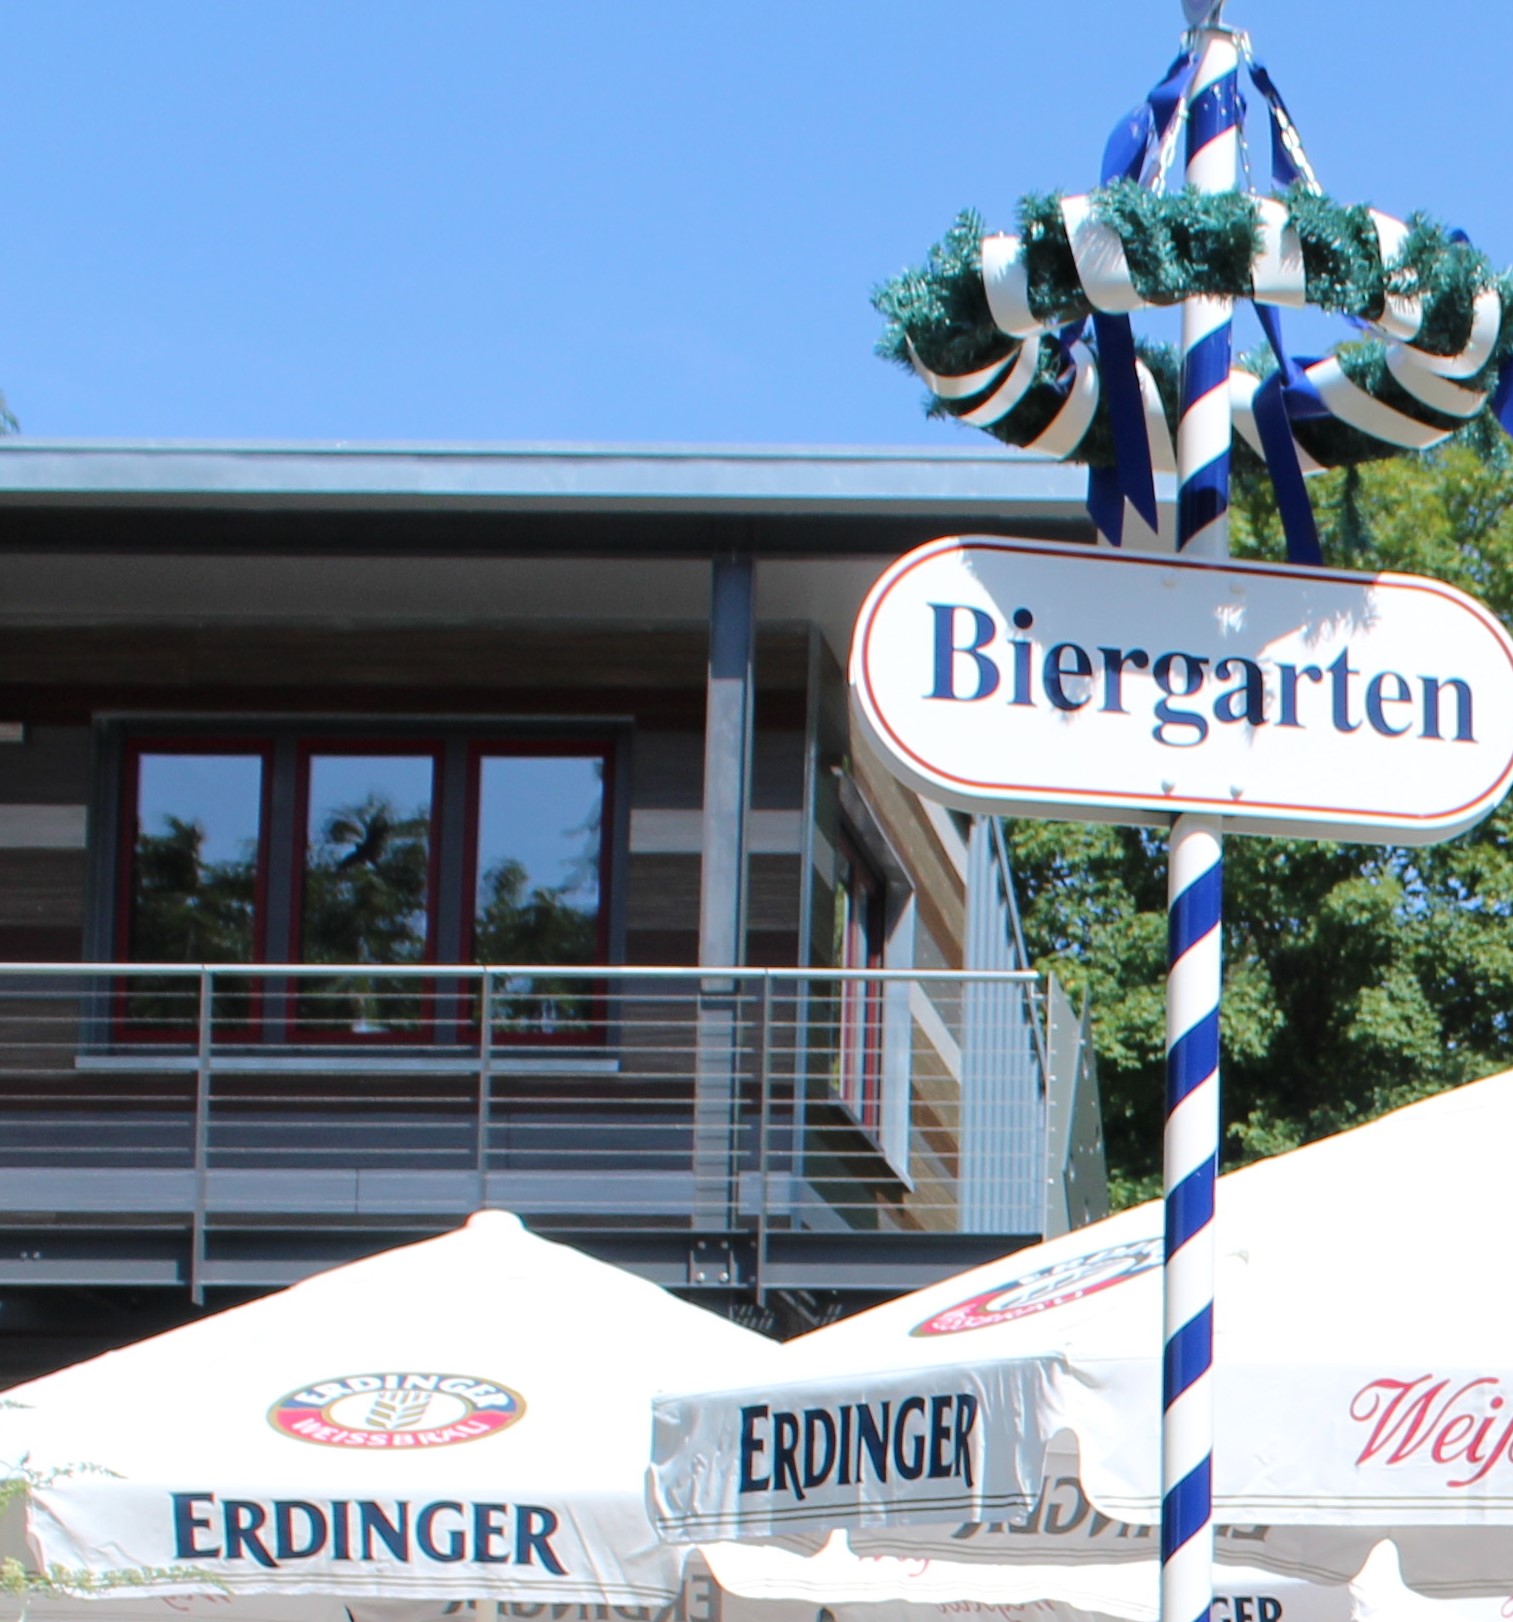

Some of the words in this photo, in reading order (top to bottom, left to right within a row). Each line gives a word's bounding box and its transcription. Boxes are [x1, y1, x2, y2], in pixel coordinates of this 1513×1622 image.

[922, 602, 1479, 747] Biergarten
[293, 1375, 510, 1409] ERDINGER
[738, 1393, 979, 1500] ERDINGER
[171, 1491, 568, 1577] ERDINGER
